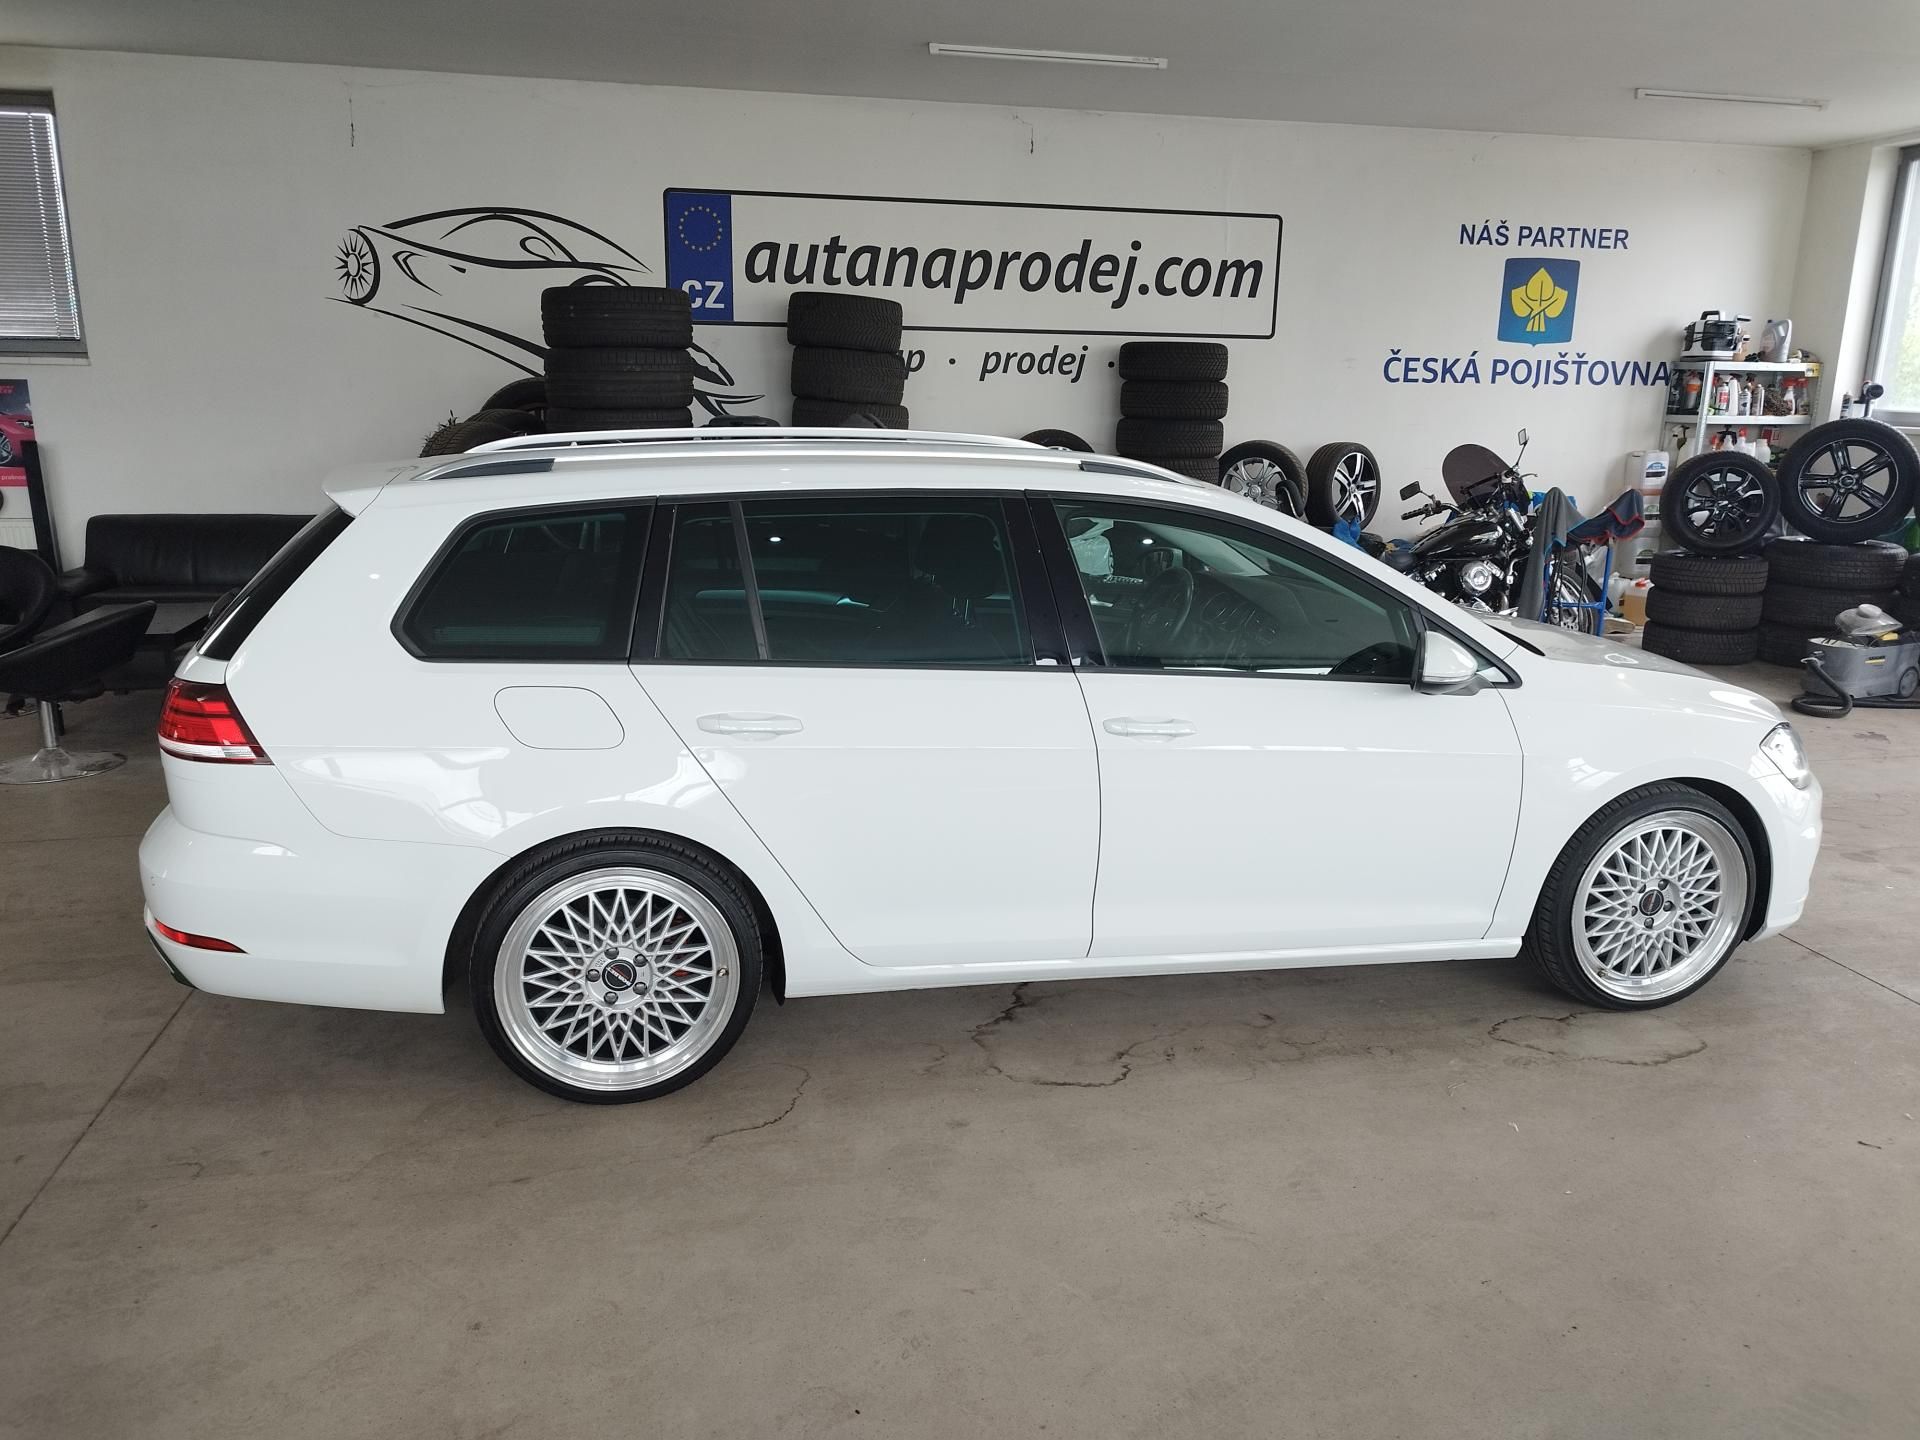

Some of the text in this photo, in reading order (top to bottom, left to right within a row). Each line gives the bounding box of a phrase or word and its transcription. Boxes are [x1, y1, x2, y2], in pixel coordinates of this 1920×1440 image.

[1459, 219, 1629, 250] NÁŠ PARTNER
[744, 234, 1264, 310] autanaprodej.com
[682, 280, 725, 309] CZ
[979, 345, 1088, 384] prodej
[1384, 349, 1669, 389] ČESKÁ POJIŠŤOVNA
